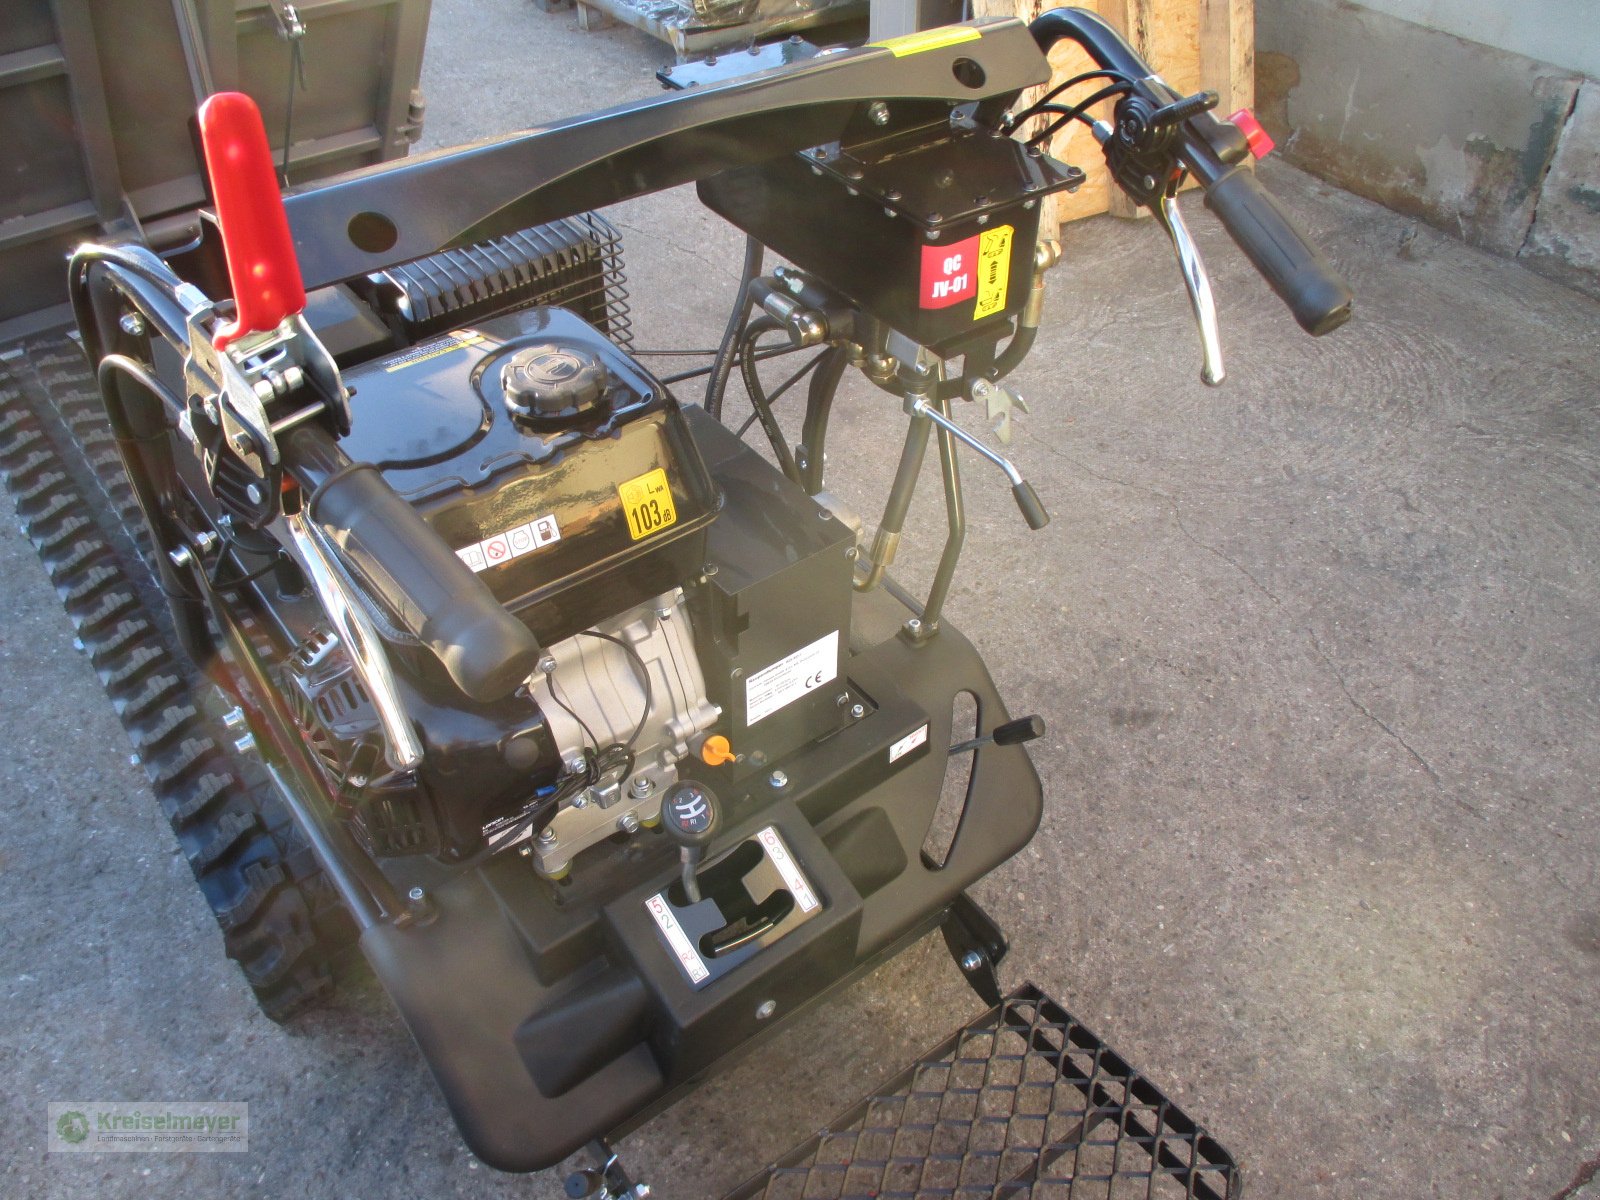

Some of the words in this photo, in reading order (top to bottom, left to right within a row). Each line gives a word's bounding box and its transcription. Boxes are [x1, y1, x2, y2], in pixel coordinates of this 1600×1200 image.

[943, 254, 962, 275] QC
[931, 273, 968, 298] JV-01
[632, 499, 661, 534] 103
[763, 831, 776, 846] 6
[772, 846, 785, 860] 3
[651, 899, 663, 914] 5
[661, 914, 674, 930] 2
[681, 950, 695, 963] R2
